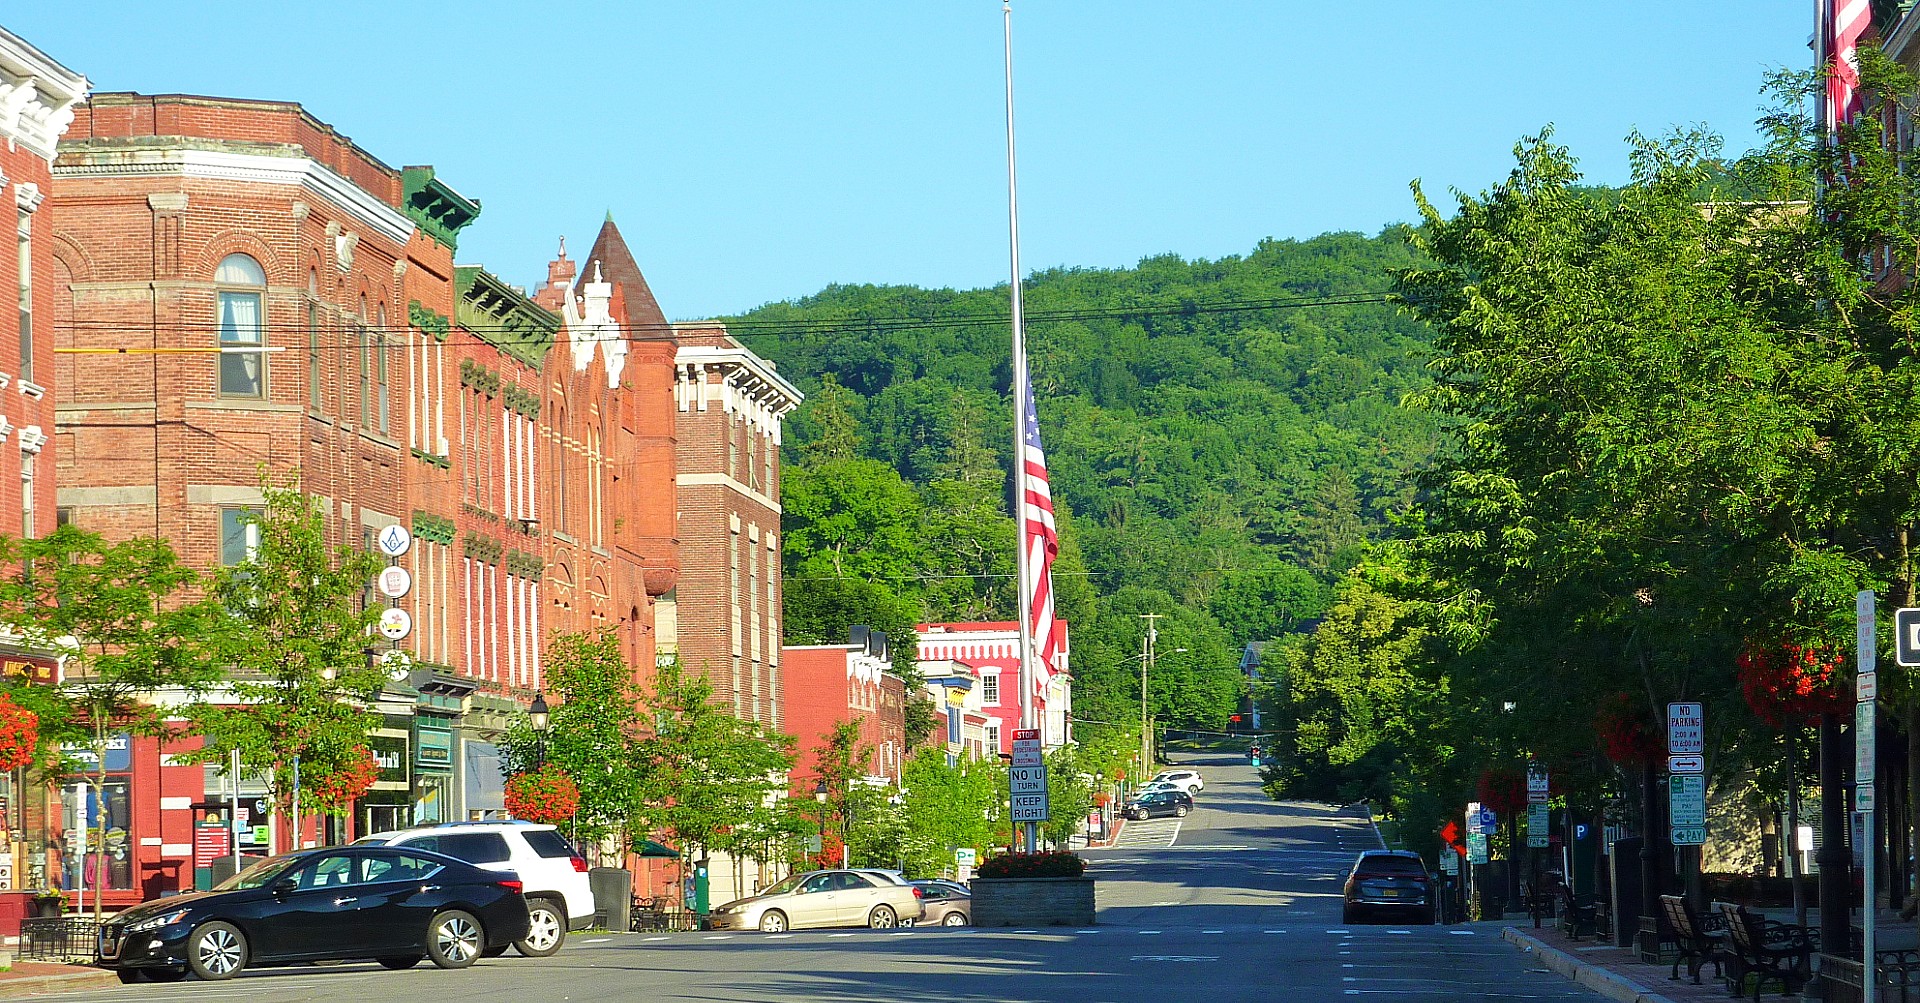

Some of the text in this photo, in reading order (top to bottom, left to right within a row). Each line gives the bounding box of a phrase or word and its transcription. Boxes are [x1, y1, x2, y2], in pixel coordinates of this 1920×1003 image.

[1680, 705, 1690, 715] NO
[1671, 717, 1700, 727] PARKING
[1017, 731, 1034, 739] STOP
[1675, 731, 1687, 739] 2:00
[1012, 770, 1042, 780] NO U
[1017, 782, 1038, 790] TURN
[1016, 797, 1041, 806] KEEP
[1014, 808, 1044, 818] RIGHT
[1577, 825, 1585, 837] P
[1687, 830, 1702, 841] PAY
